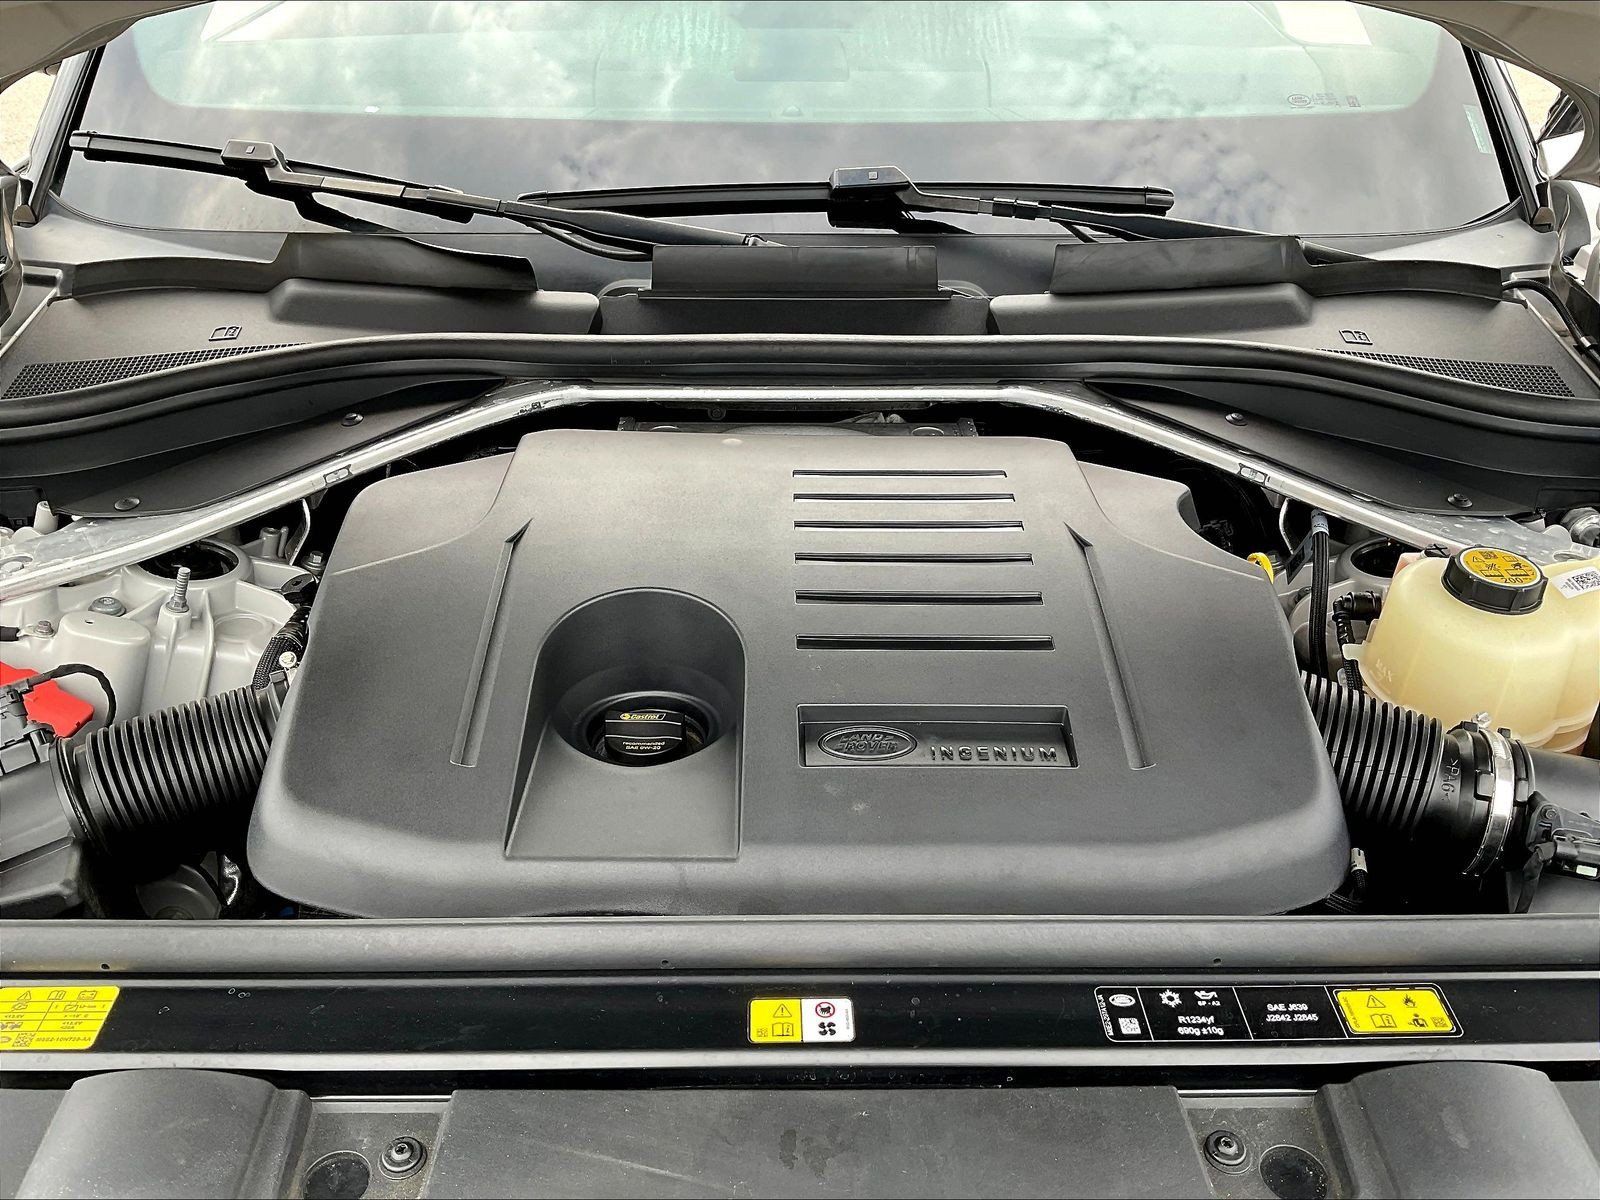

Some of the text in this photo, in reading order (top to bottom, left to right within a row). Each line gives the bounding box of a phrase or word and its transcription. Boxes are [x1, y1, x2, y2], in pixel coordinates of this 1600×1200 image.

[930, 746, 1058, 762] INGENIUM
[1266, 1003, 1309, 1012] SAE J639
[1177, 1015, 1215, 1025] R1234yf
[1266, 1013, 1319, 1022] J2842 J2845
[1177, 1026, 1224, 1036] 690g ±10g
